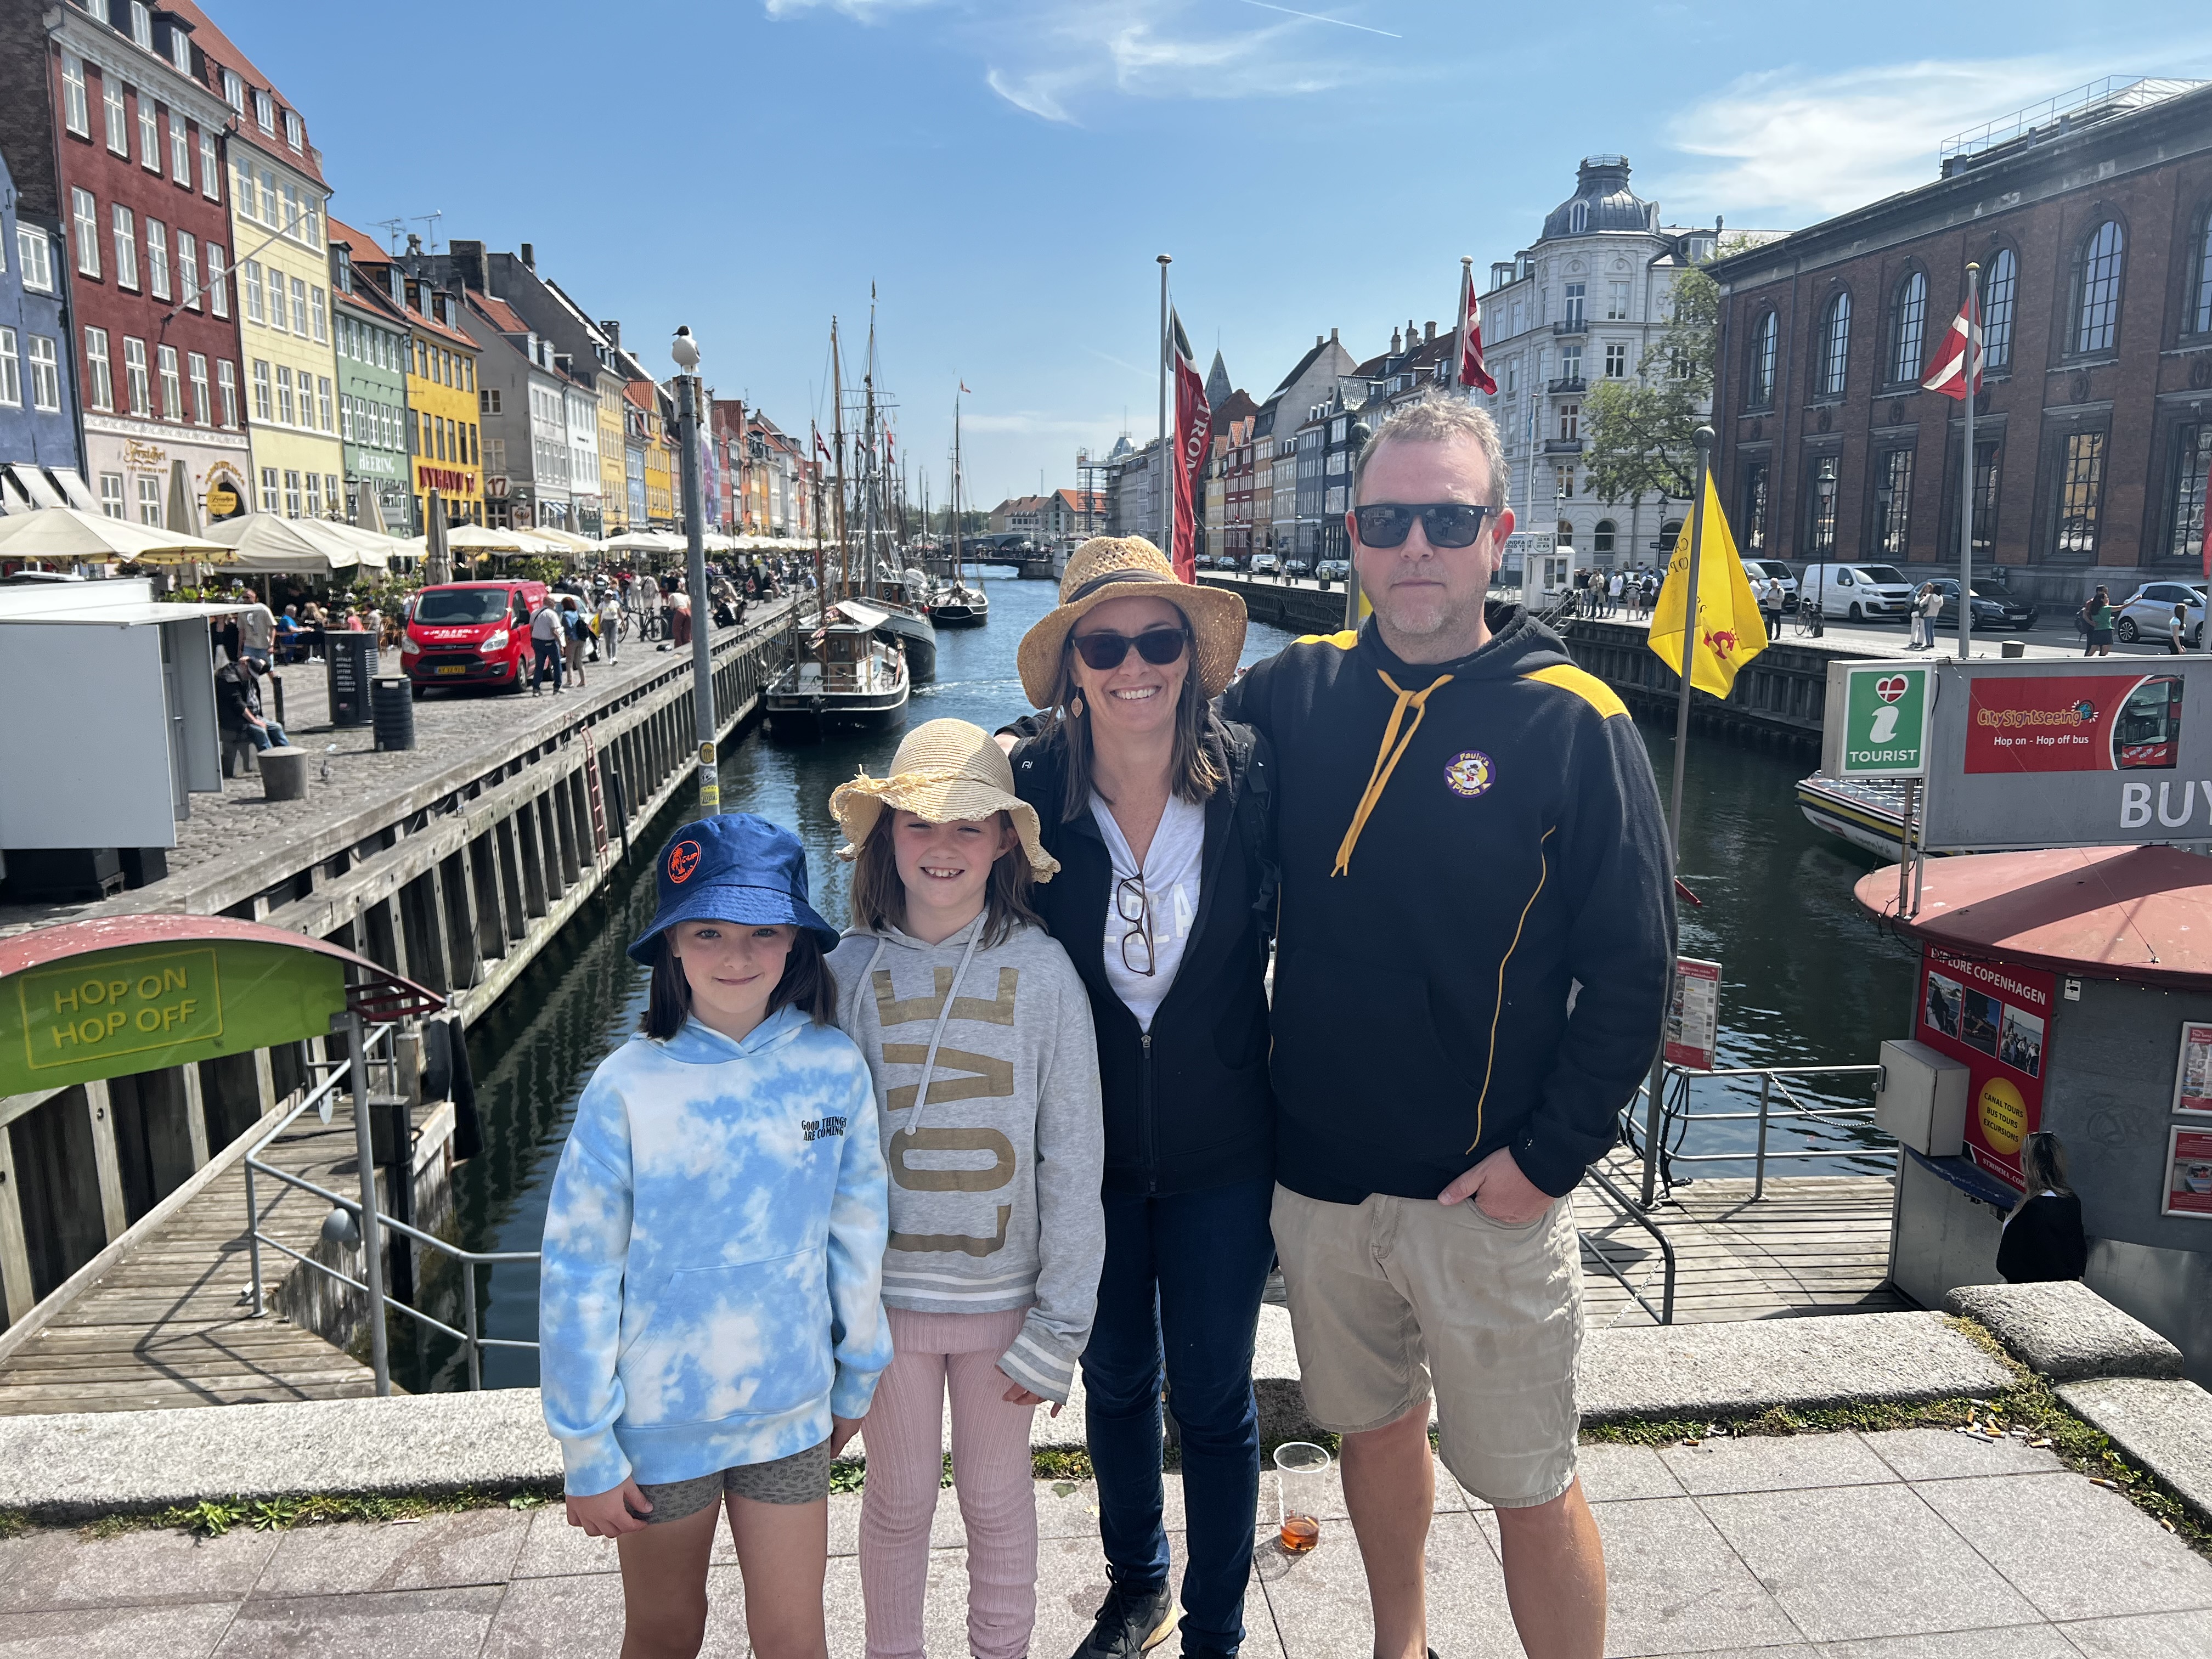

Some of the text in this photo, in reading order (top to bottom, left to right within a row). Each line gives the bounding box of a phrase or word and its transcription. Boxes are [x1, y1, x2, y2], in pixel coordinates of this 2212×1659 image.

[359, 452, 395, 474] HEERING
[487, 478, 506, 496] 17
[1977, 708, 2082, 729] CitySightseeing
[1994, 736, 2012, 747] Hop
[2036, 735, 2055, 746] Hop
[2057, 735, 2070, 744] off
[2073, 735, 2089, 744] bus
[1849, 749, 1917, 763] TOURIST
[1452, 783, 1480, 795] Pizza
[1931, 948, 2046, 1006] EXPLORE COPENHAGEN
[54, 966, 188, 1014] HOP ON
[52, 998, 198, 1049] HOP OFF
[871, 966, 1020, 1257] LOVE
[1984, 1092, 2023, 1118] CANAL TOURS
[801, 1116, 847, 1131] GOOD THINGS
[1987, 1107, 2018, 1128] BUS TOURS
[803, 1125, 844, 1141] ARE COMING
[1983, 1118, 2019, 1143] EXCURSIONS
